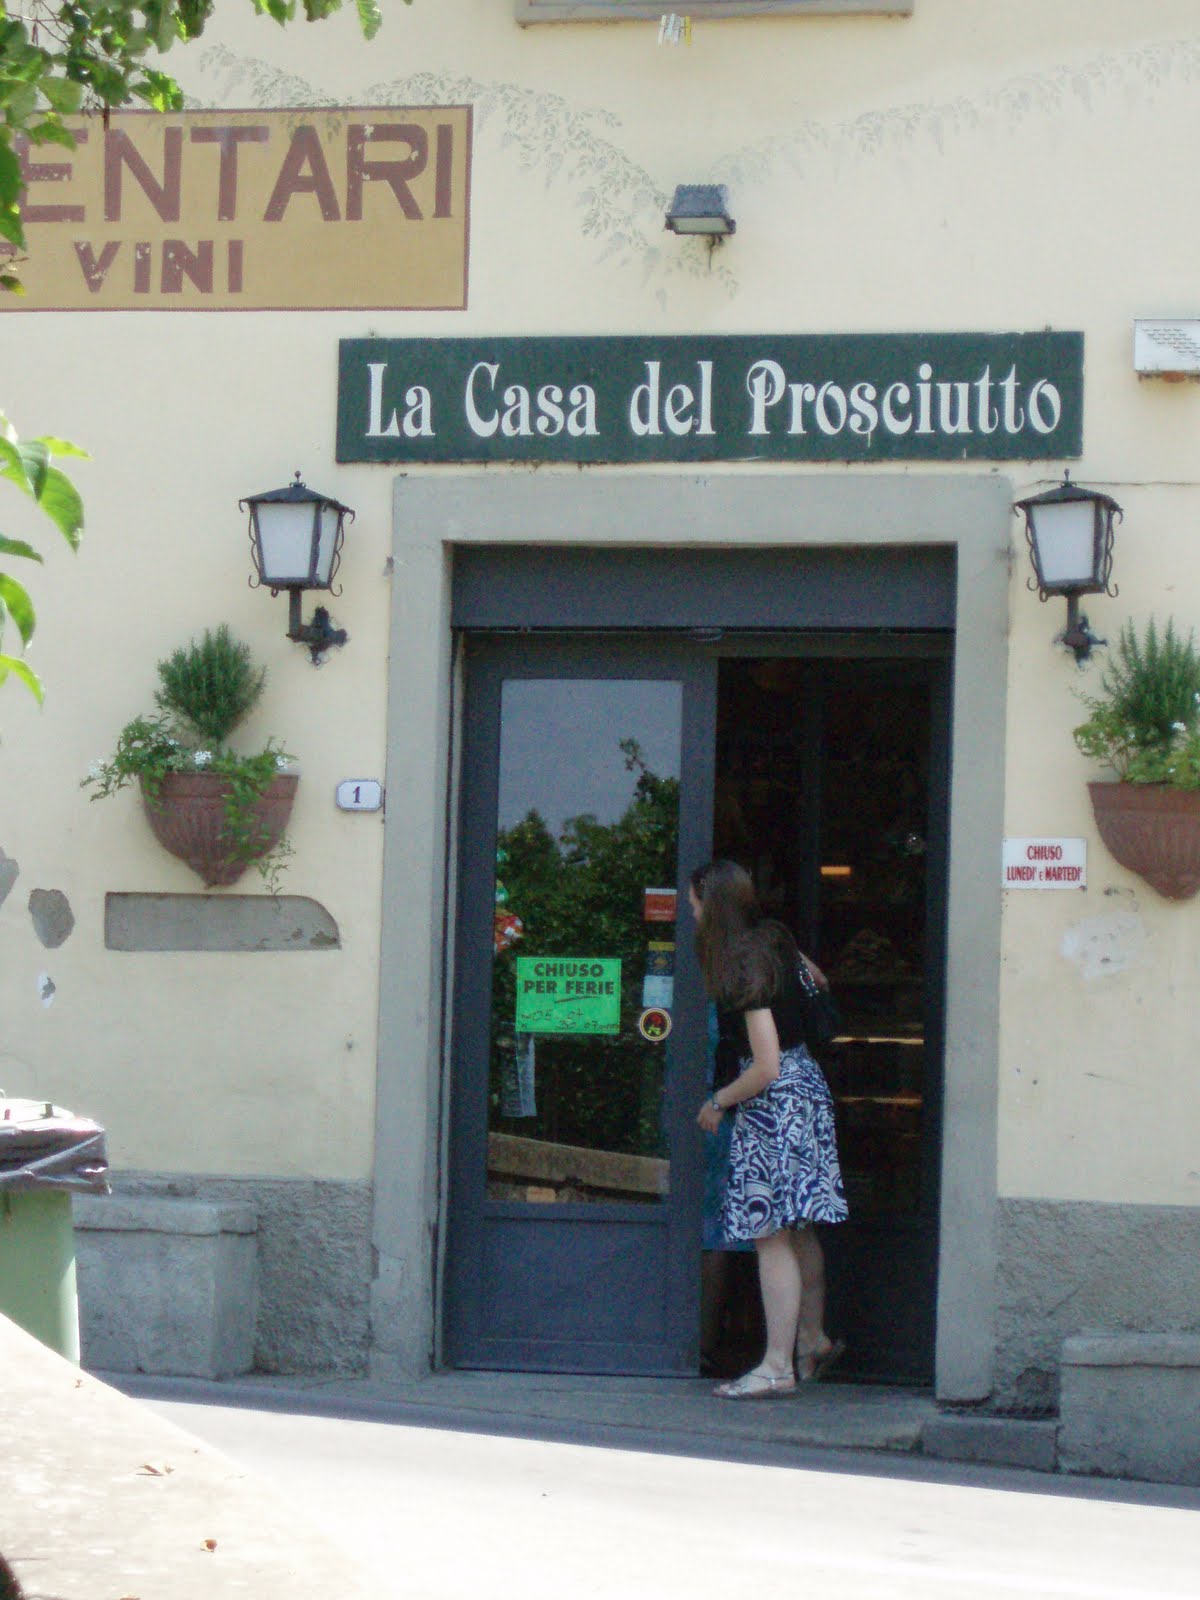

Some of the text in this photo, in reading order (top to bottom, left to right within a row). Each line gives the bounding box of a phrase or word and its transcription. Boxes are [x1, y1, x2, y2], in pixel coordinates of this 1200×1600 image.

[17, 124, 453, 222] ENTARI
[74, 240, 243, 293] VINI
[365, 360, 1062, 437] La Casa del Prosciutto
[353, 786, 360, 803] 1
[1027, 846, 1062, 860] CHIUSO
[534, 963, 604, 977] CHIUSO
[524, 980, 614, 994] PER FERIE
